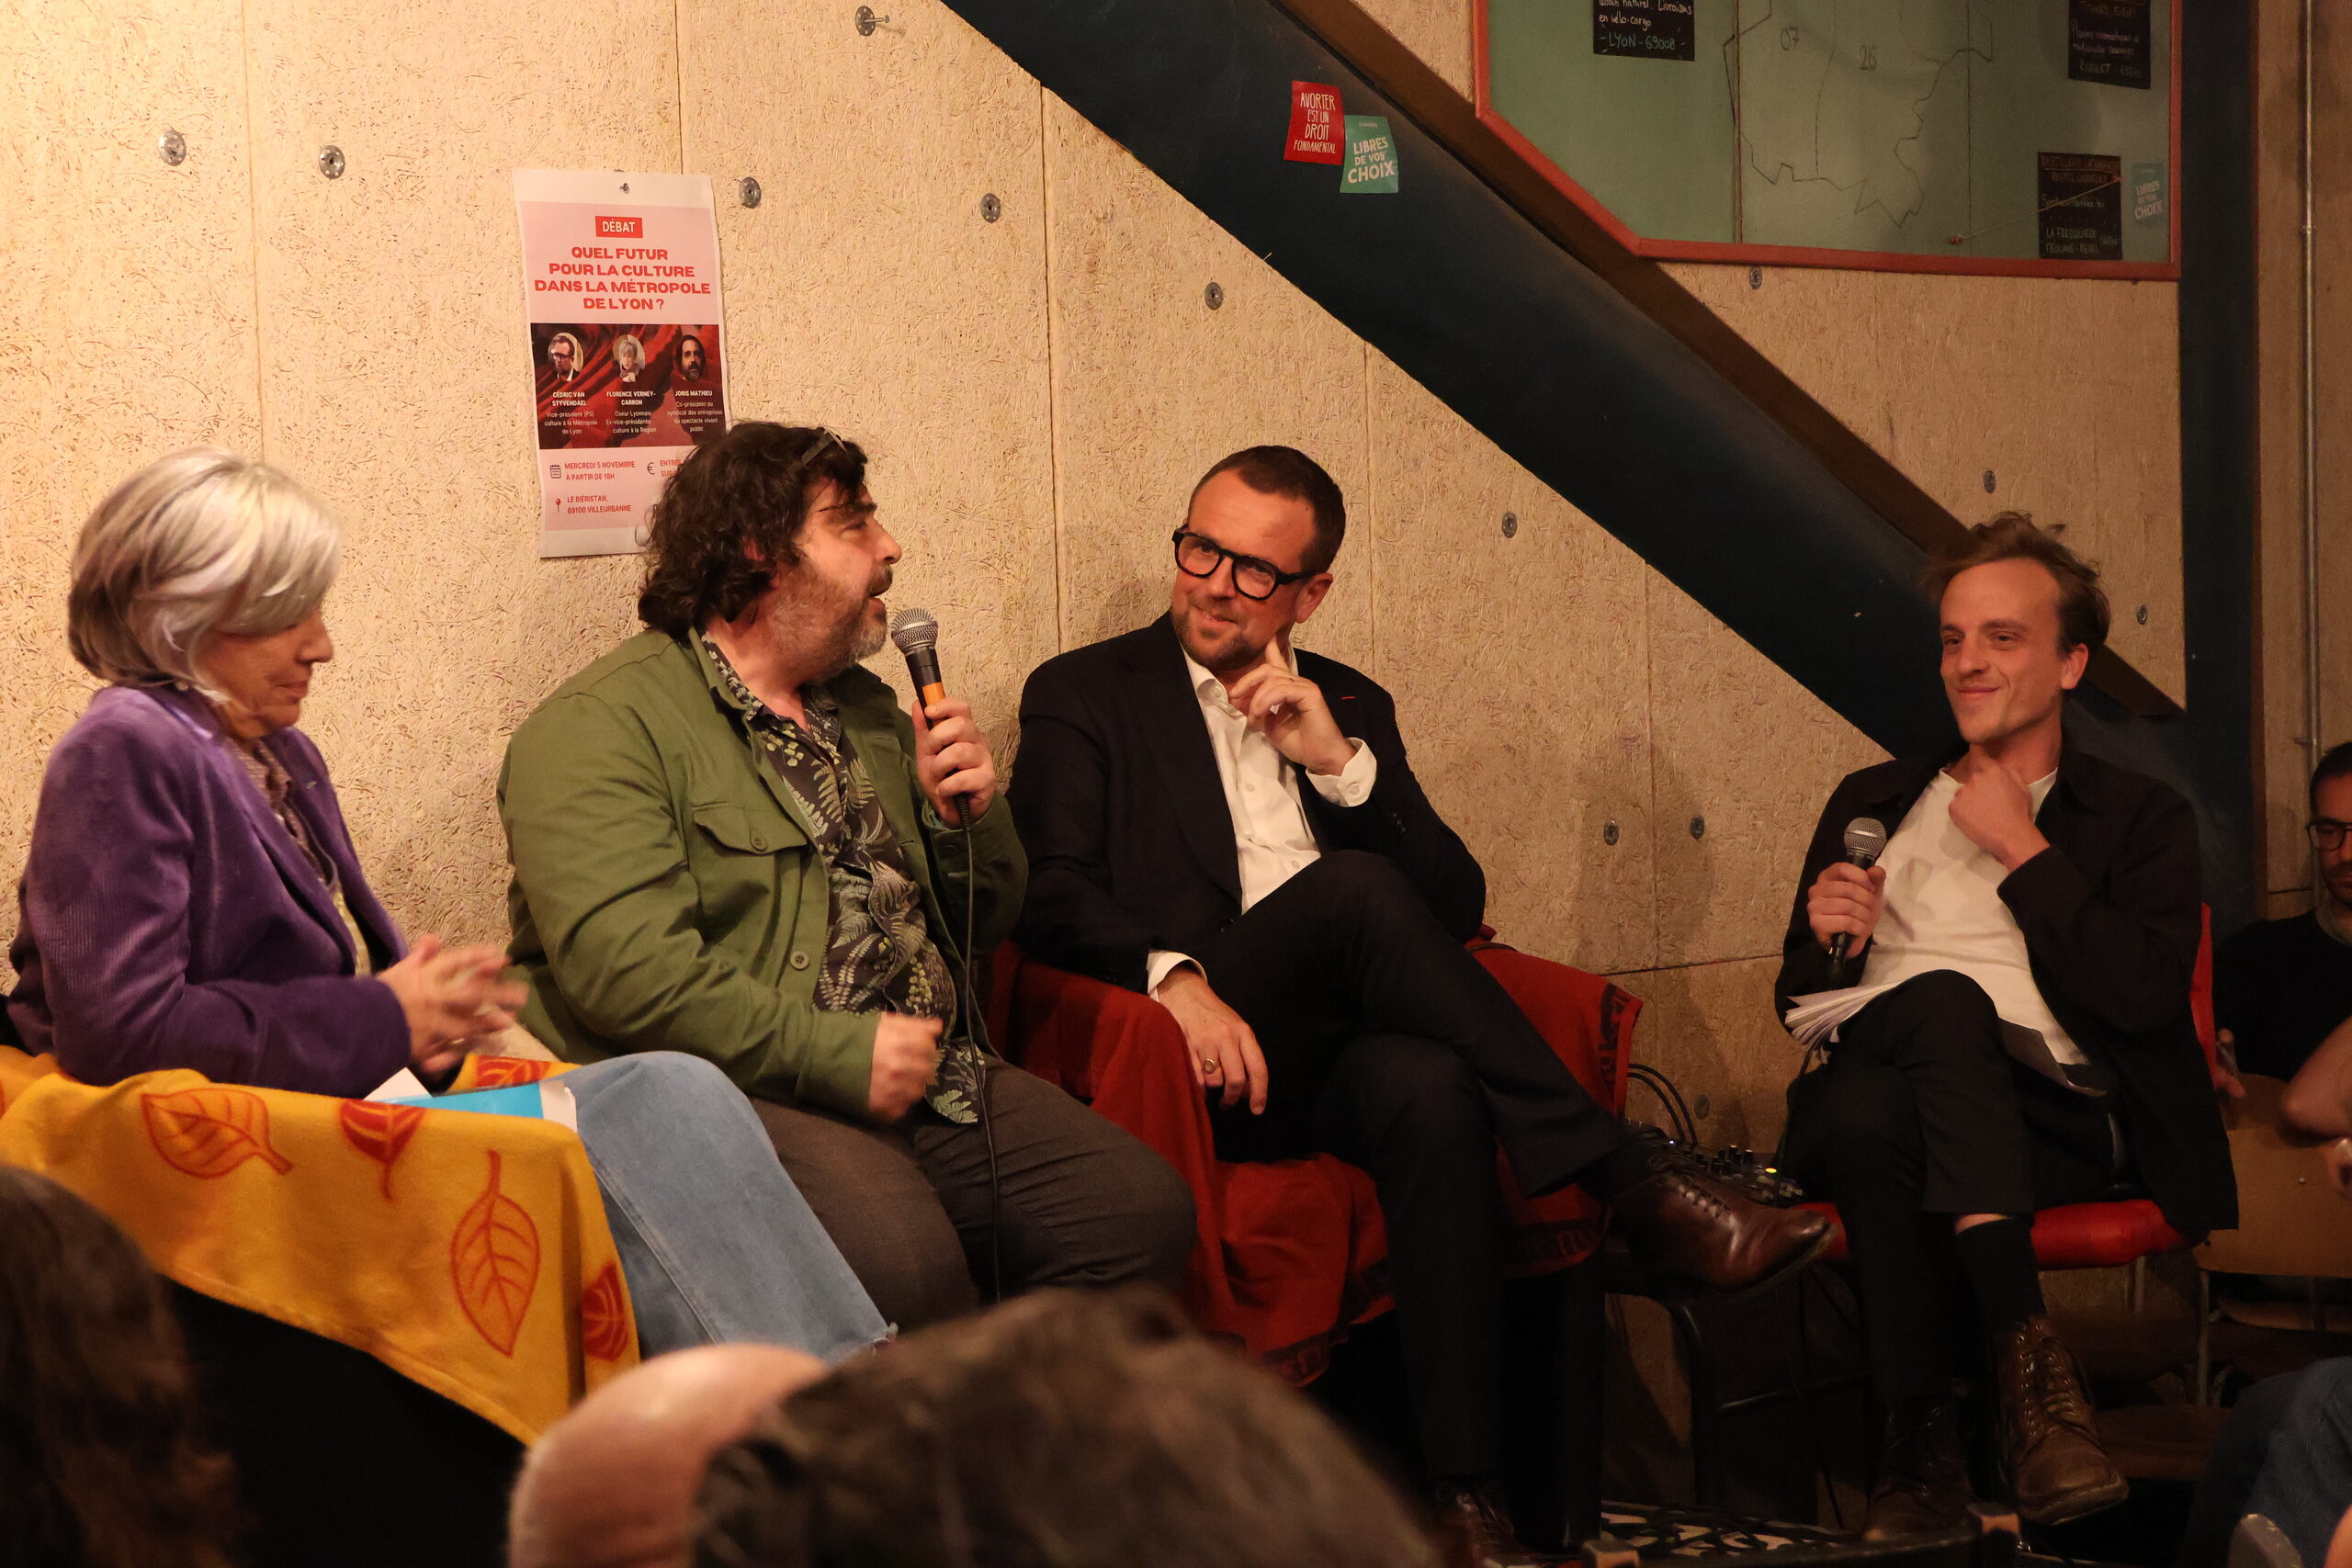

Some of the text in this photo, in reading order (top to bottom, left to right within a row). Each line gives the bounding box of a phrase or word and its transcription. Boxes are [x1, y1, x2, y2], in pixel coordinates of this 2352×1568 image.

[1609, 31, 1635, 49] LYON
[1645, 36, 1676, 50] 69008
[1781, 26, 1800, 51] 07
[1300, 92, 1336, 110] AVORTER
[1307, 110, 1329, 123] EST UN
[1305, 124, 1329, 141] DROIT
[1294, 140, 1336, 154] FONDAMENTAL
[1353, 136, 1389, 155] LIBRES
[1354, 152, 1385, 166] DE VOS
[1348, 161, 1396, 184] CHOIX
[2134, 198, 2163, 220] CHOIX
[603, 219, 636, 232] DÉBAT
[571, 247, 668, 260] QUEL FUTUR
[548, 263, 695, 277] POUR LA CULTURE
[535, 278, 711, 294] DANS LA MÉTROPOLE
[583, 298, 605, 310] DE
[609, 299, 653, 310] LYON
[602, 460, 636, 468] NOVEMBRE
